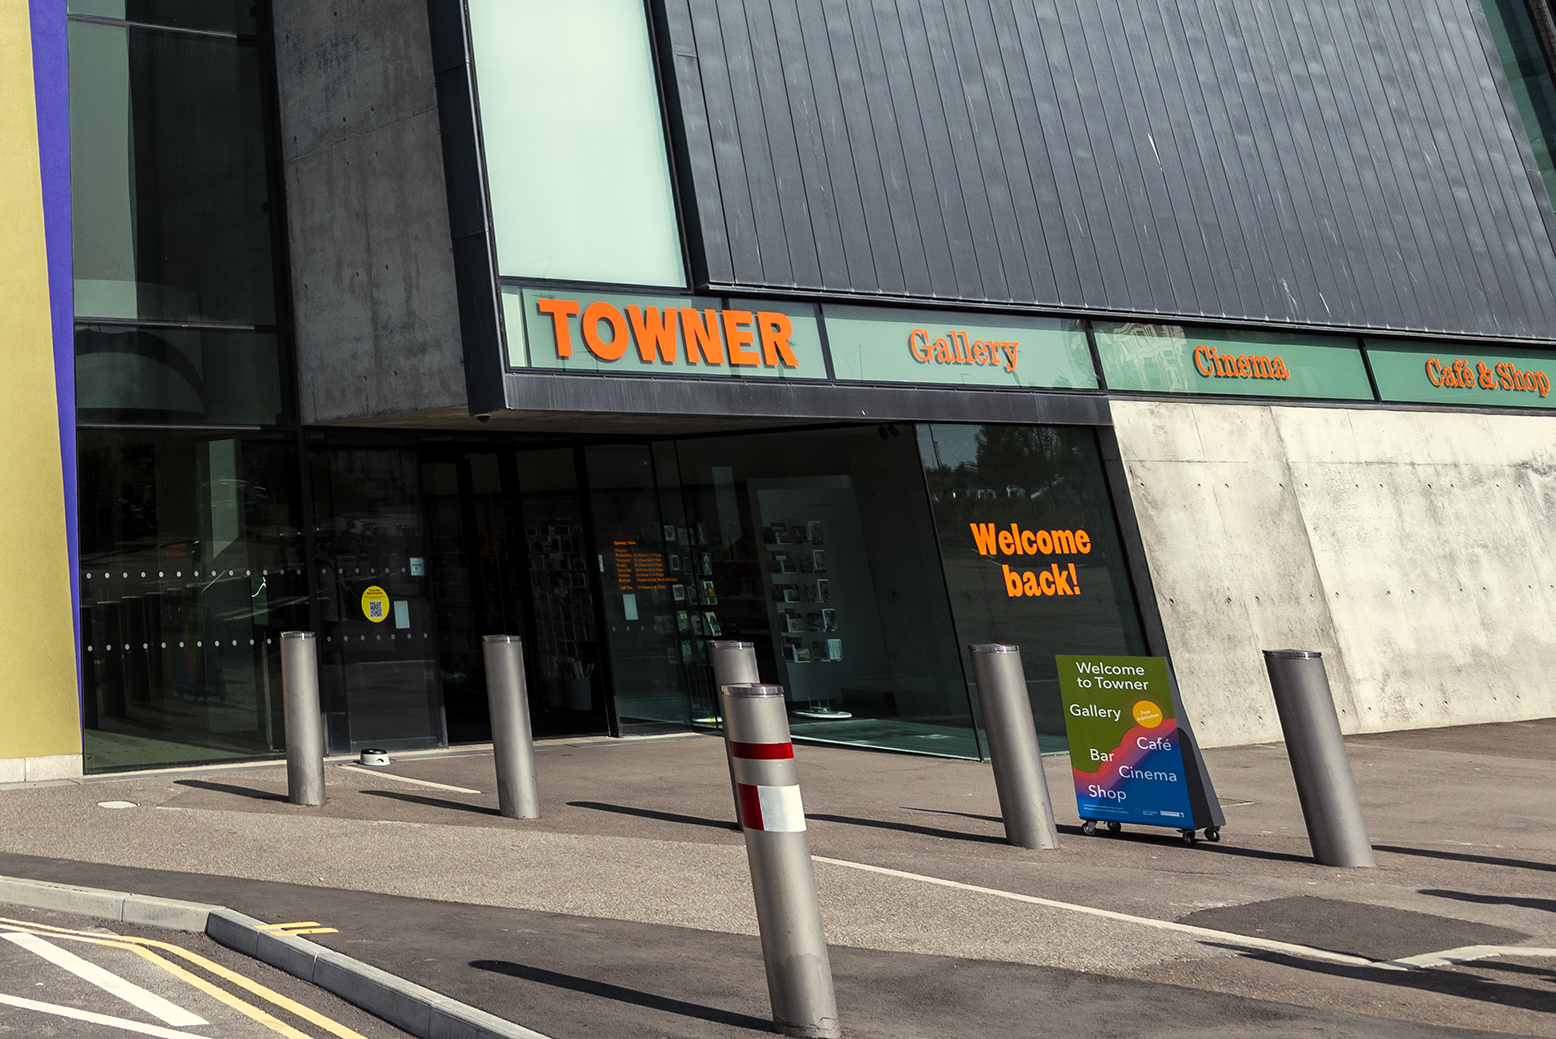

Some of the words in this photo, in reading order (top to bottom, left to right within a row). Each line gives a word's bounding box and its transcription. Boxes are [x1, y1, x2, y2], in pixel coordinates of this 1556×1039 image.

[538, 298, 800, 367] TOWNER
[909, 328, 1020, 372] Gallery
[1194, 345, 1291, 379] Cinema
[1426, 358, 1476, 388] Café
[1477, 360, 1498, 389] &
[1497, 362, 1551, 397] Shop
[969, 522, 1092, 556] Welcome
[1001, 562, 1081, 598] back!
[1075, 661, 1145, 676] Welcome
[1076, 677, 1092, 689] to
[1094, 676, 1149, 691] Towner
[1069, 703, 1121, 722] Gallery
[1136, 736, 1172, 751] Café
[1089, 748, 1115, 762] Bar
[1118, 765, 1178, 782] Cinema
[1088, 784, 1127, 803] Shop
